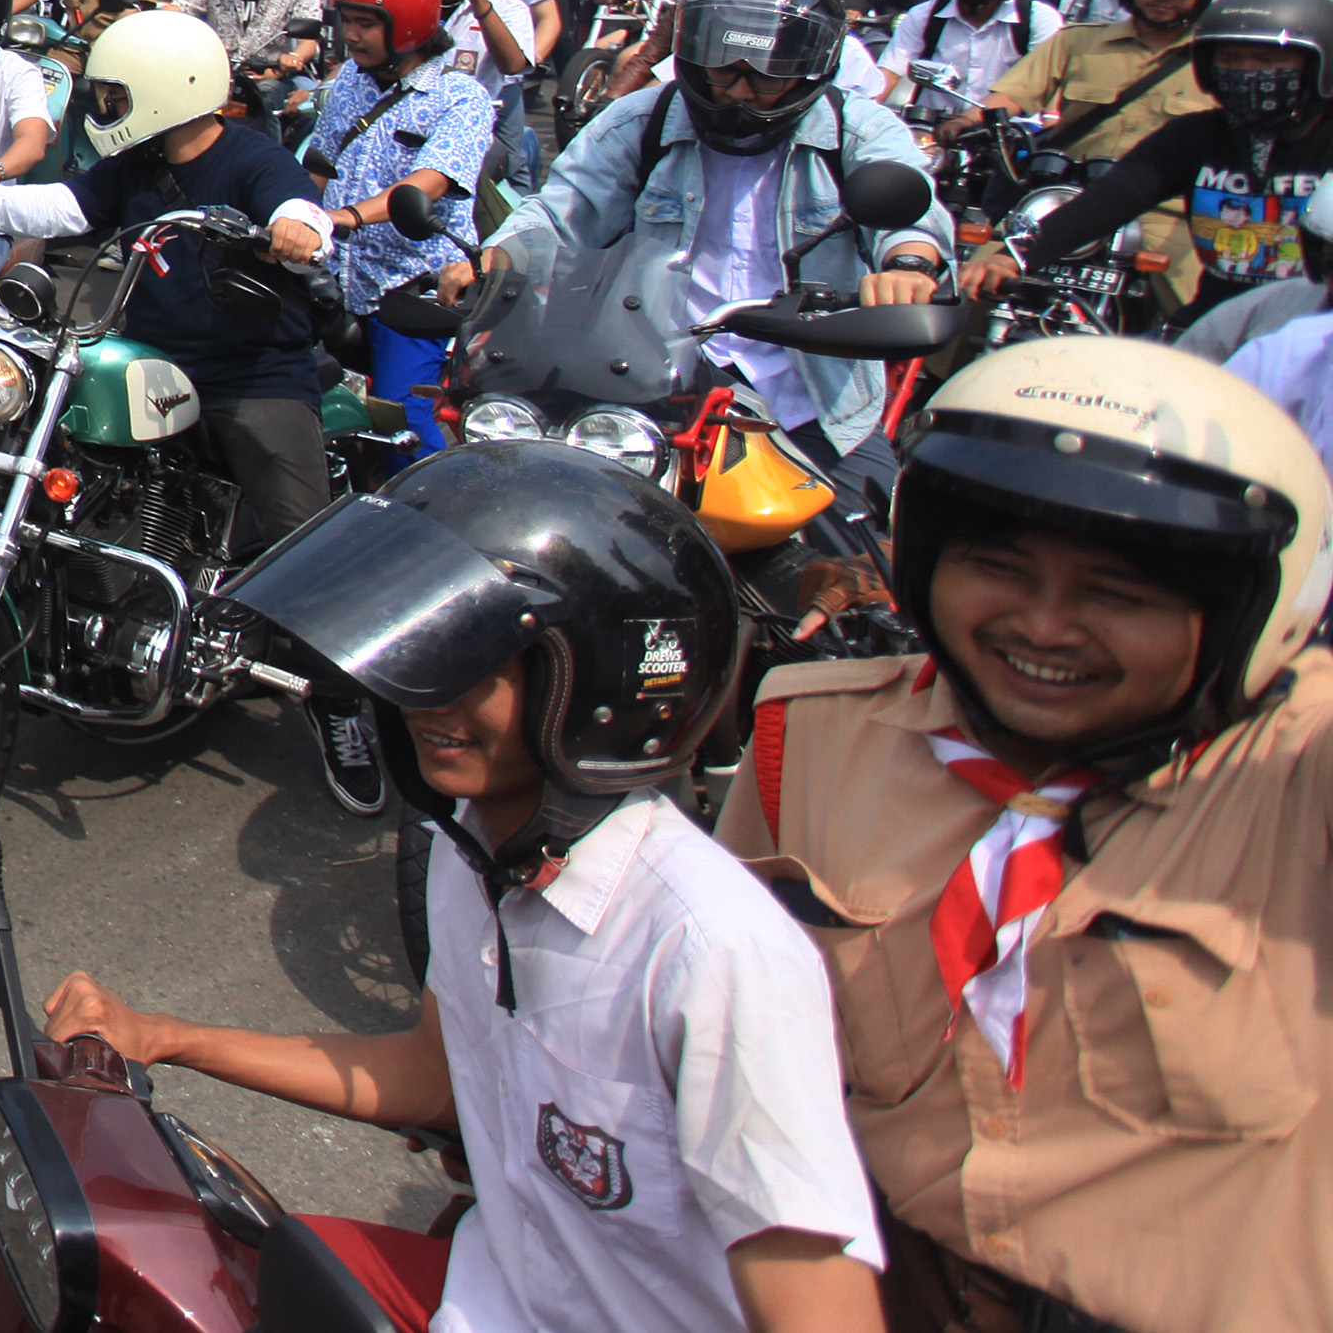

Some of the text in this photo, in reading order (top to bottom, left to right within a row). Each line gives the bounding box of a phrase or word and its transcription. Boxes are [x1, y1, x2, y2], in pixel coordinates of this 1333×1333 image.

[726, 33, 771, 48] SIMPSON
[1080, 266, 1119, 283] TSB
[644, 650, 682, 662] DREWS
[637, 661, 687, 674] SCOOTER
